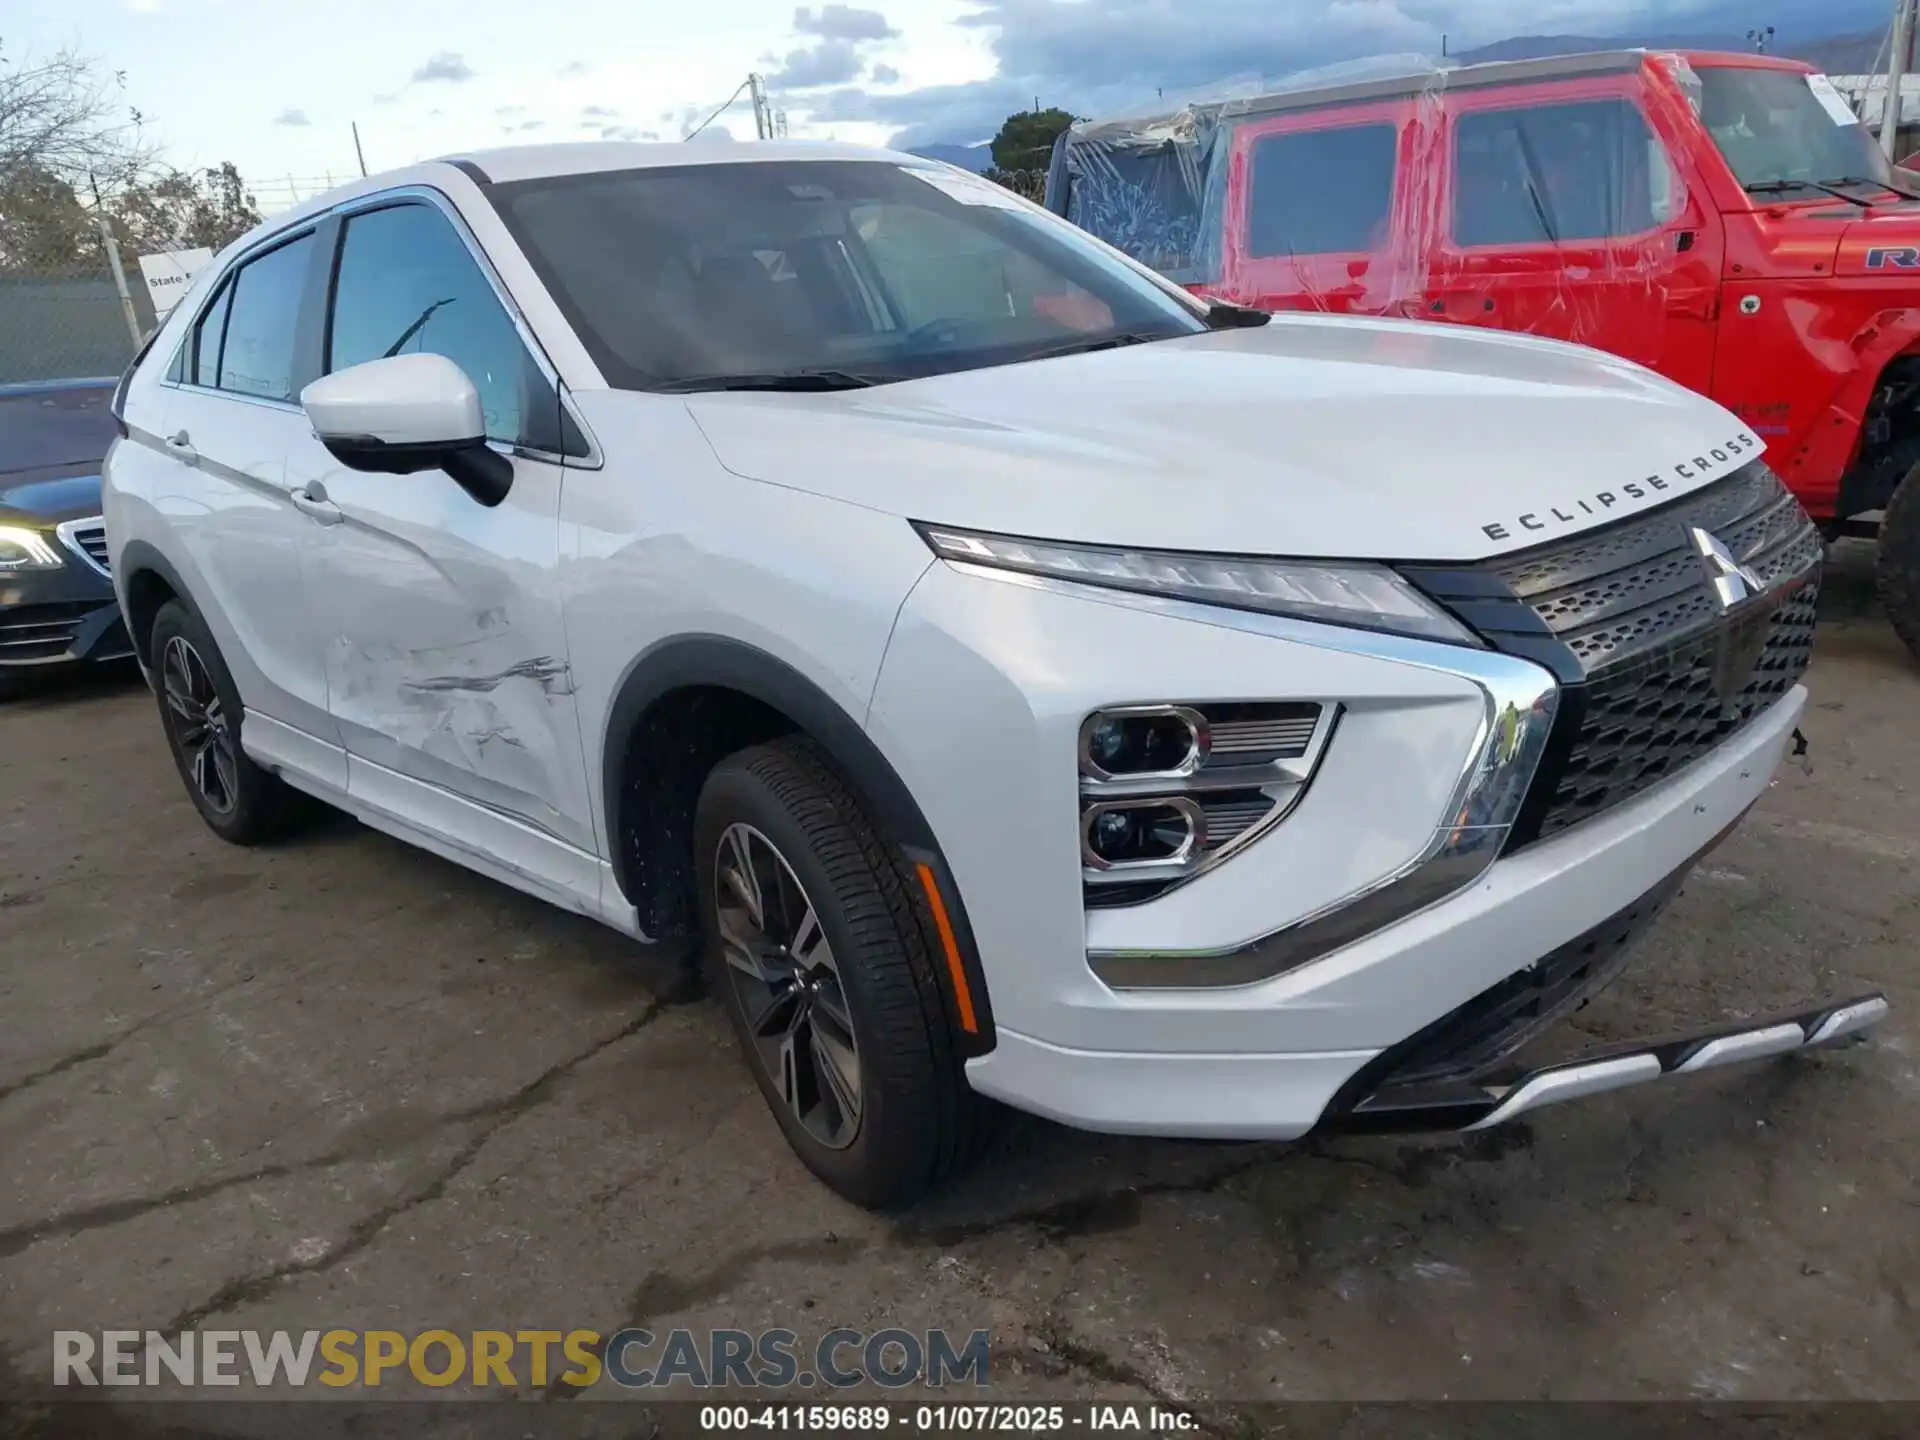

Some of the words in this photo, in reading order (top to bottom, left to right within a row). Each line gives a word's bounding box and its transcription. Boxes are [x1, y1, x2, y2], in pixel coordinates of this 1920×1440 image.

[149, 275, 183, 288] State
[1481, 475, 1669, 541] ECLIPSE
[1674, 433, 1754, 479] CROSS
